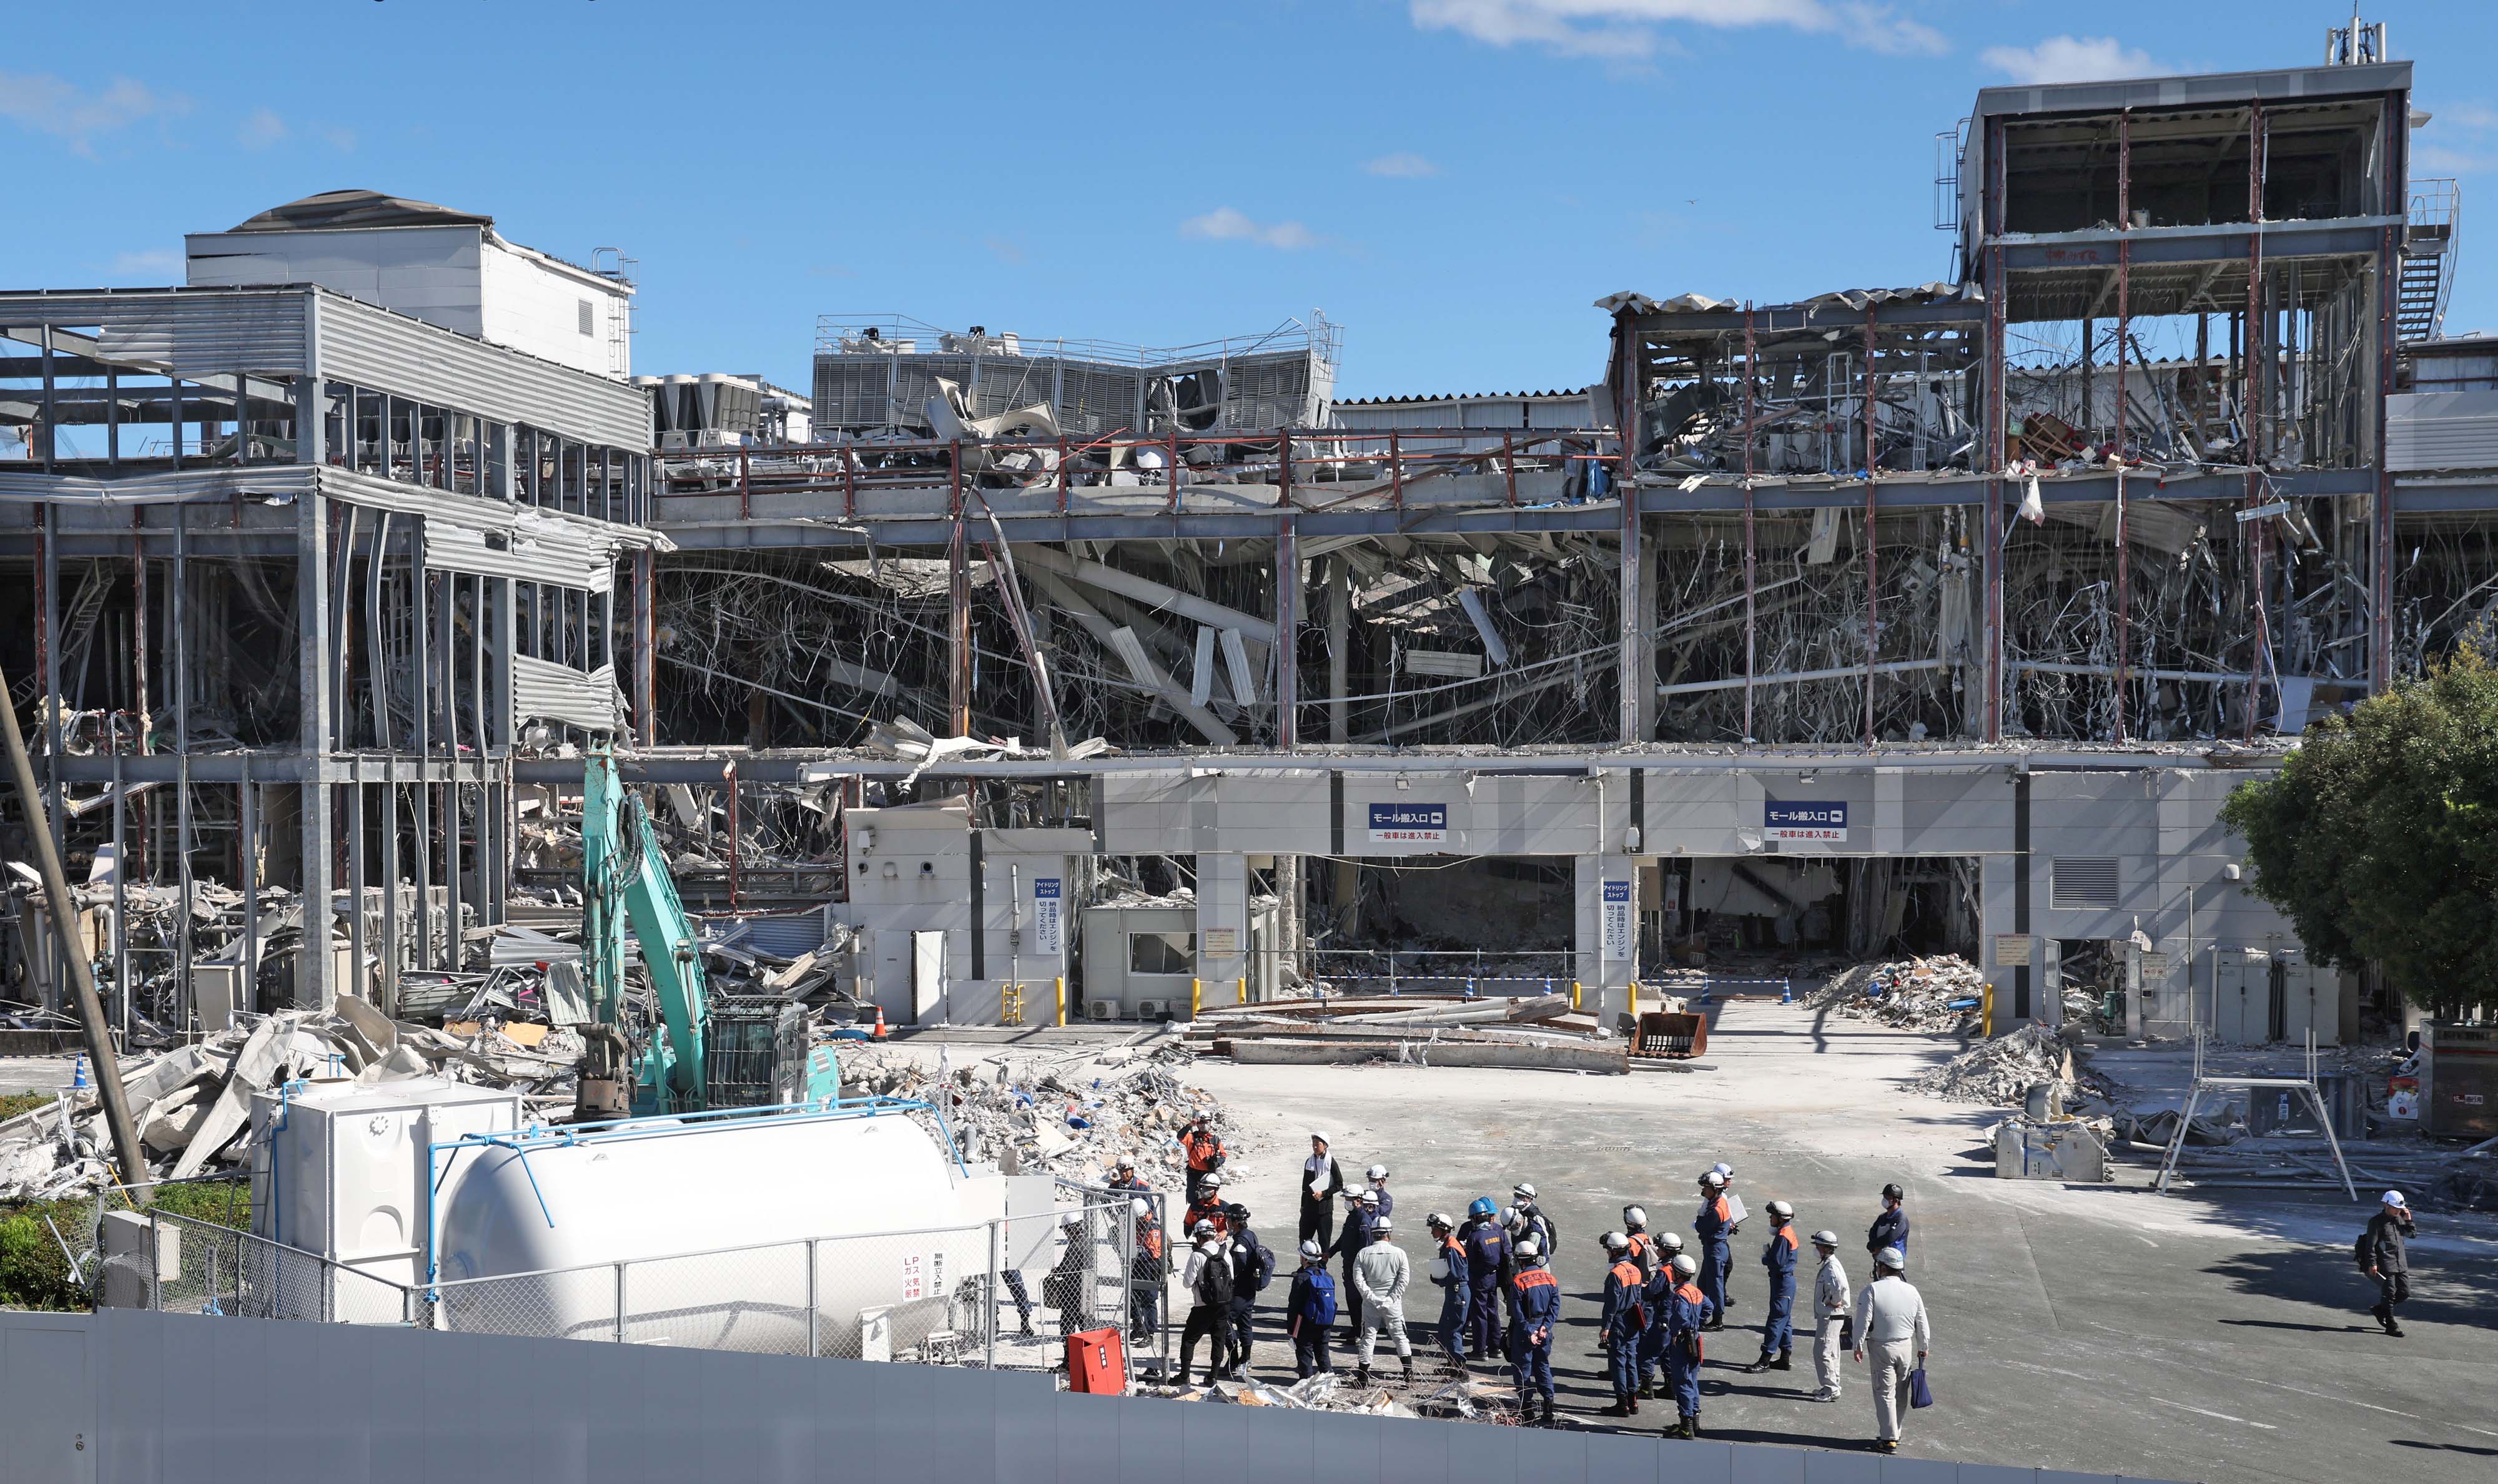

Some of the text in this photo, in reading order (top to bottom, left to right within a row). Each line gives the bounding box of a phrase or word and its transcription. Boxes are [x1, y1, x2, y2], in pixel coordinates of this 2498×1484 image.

[1373, 813, 1428, 823] モール搬入口
[1375, 832, 1440, 840] 一般車は進入禁止
[1769, 811, 1827, 822] モール搬入口
[1771, 830, 1839, 838] 一般車は進入禁止
[1039, 900, 1047, 940] 切ってください
[1049, 901, 1057, 952] 納品時はエンジンを
[1606, 904, 1615, 945] 切ってください
[1617, 905, 1626, 958] 納品時はエンジンを
[933, 1252, 944, 1295] 無断立入禁止
